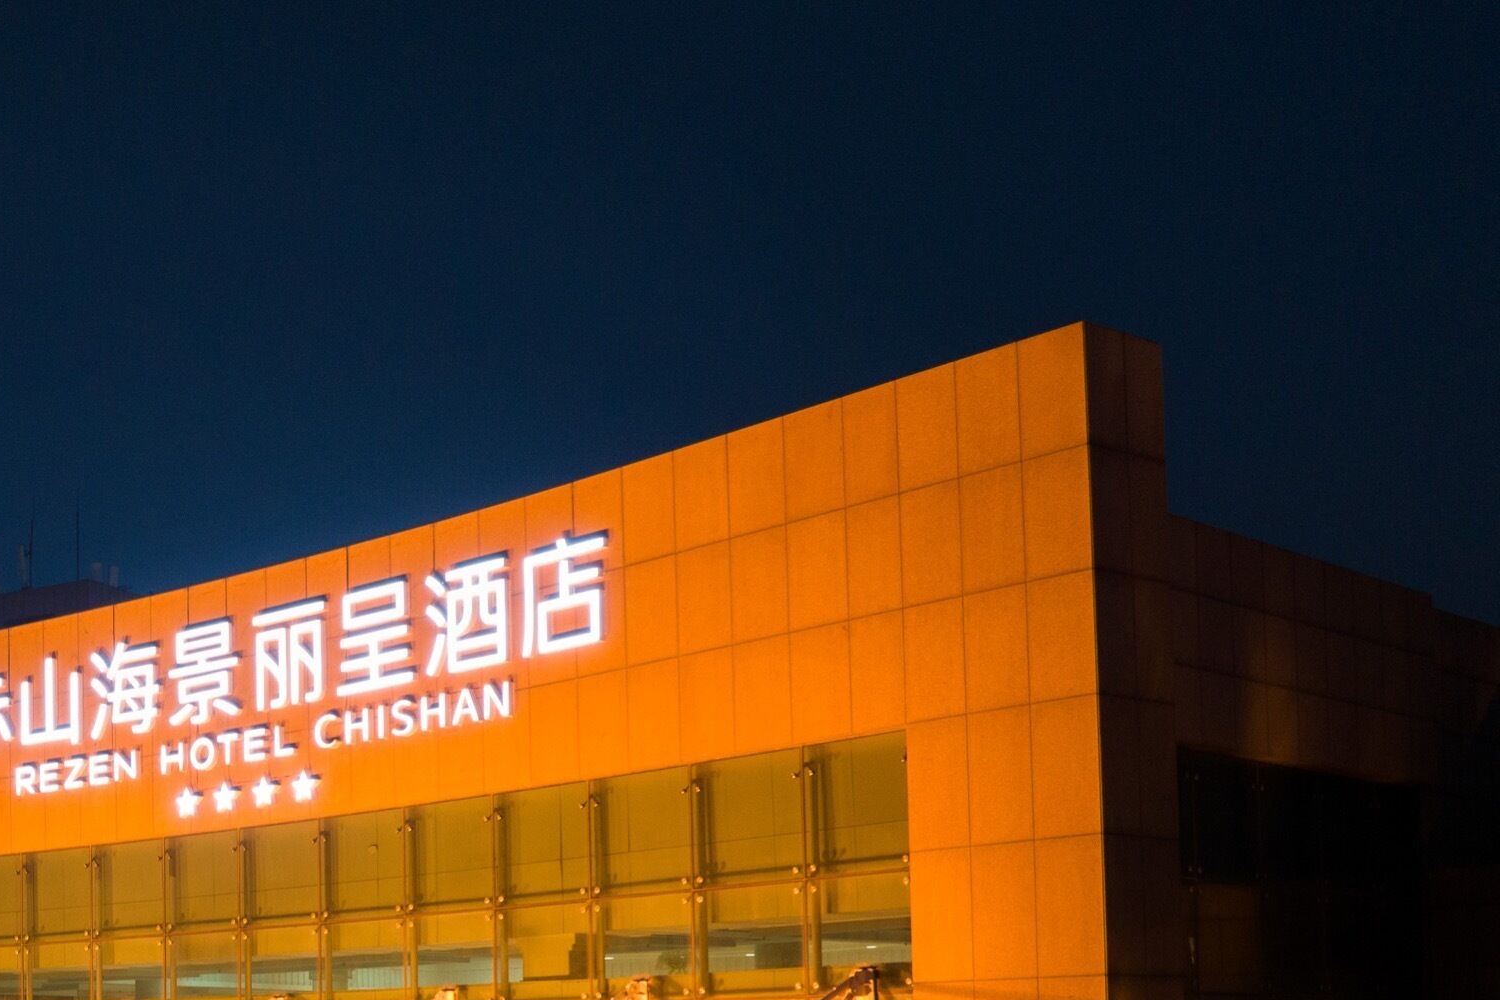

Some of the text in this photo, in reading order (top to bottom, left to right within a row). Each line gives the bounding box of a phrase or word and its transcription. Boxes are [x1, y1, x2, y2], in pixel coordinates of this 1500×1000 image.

[13, 681, 511, 796] REZEN HOTEL CHISHAN
